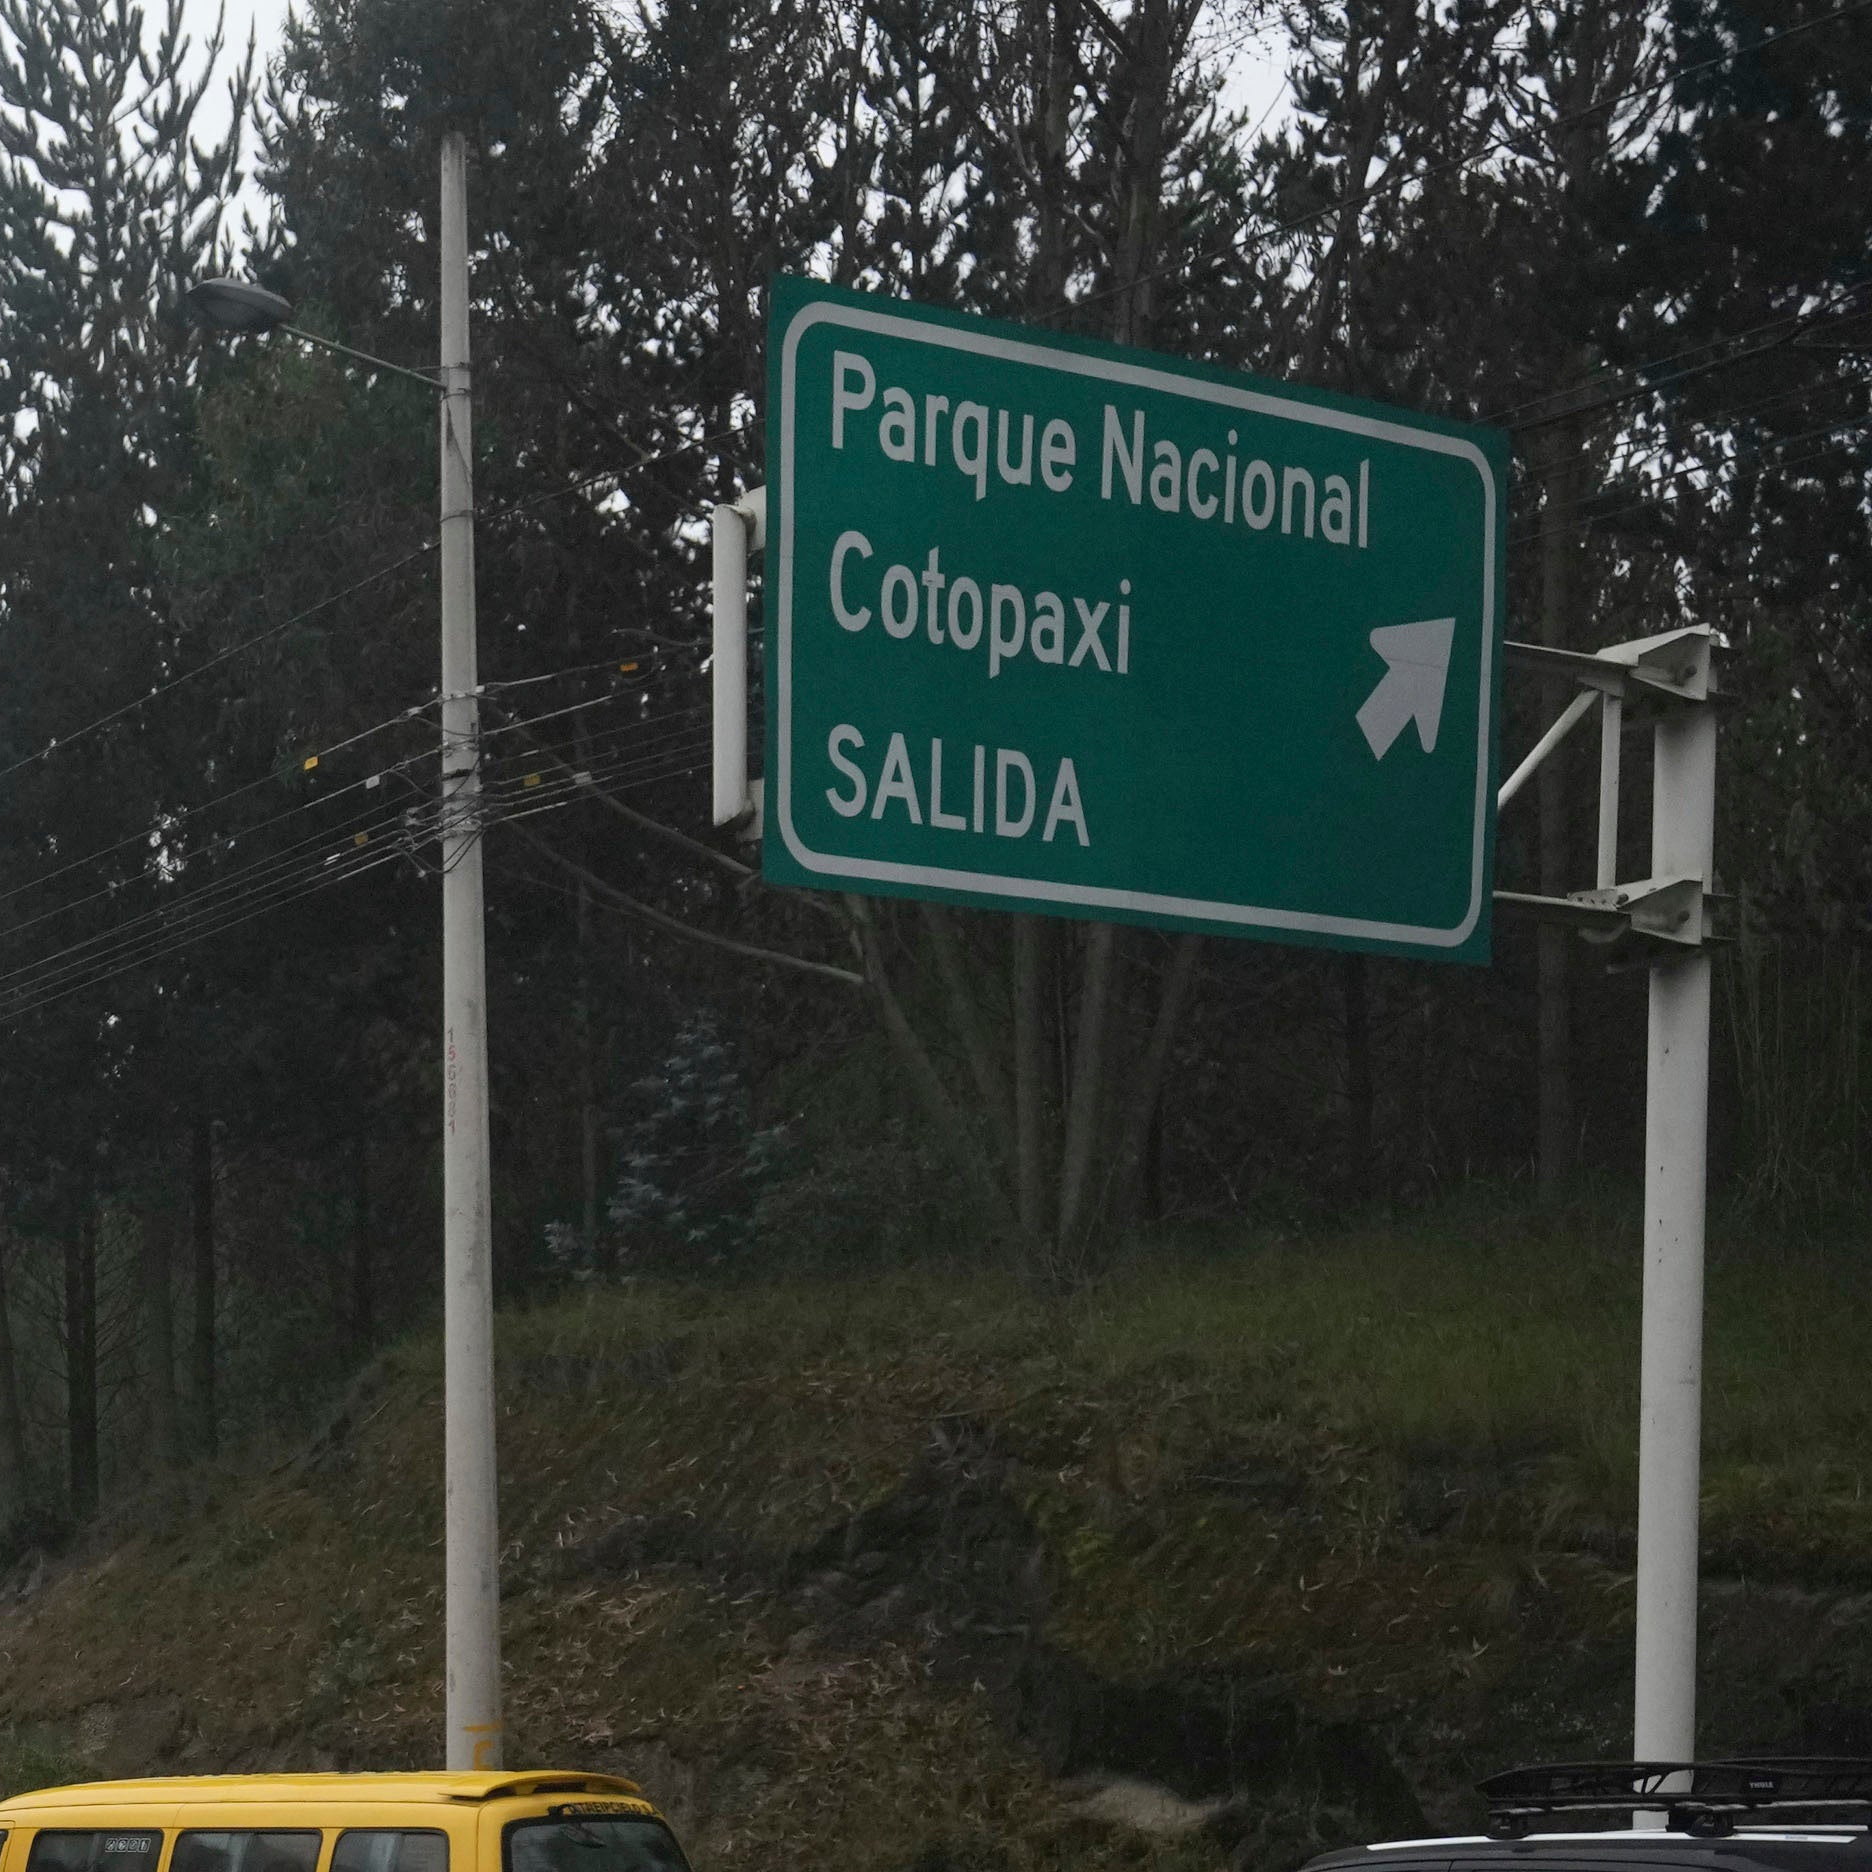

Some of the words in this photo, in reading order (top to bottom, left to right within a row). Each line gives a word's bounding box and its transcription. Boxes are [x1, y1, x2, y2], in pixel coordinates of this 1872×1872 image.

[832, 350, 1076, 500] Parque
[1101, 404, 1370, 548] Nacional
[829, 530, 1131, 679] Cotopaxi
[825, 723, 1090, 847] SALIDA
